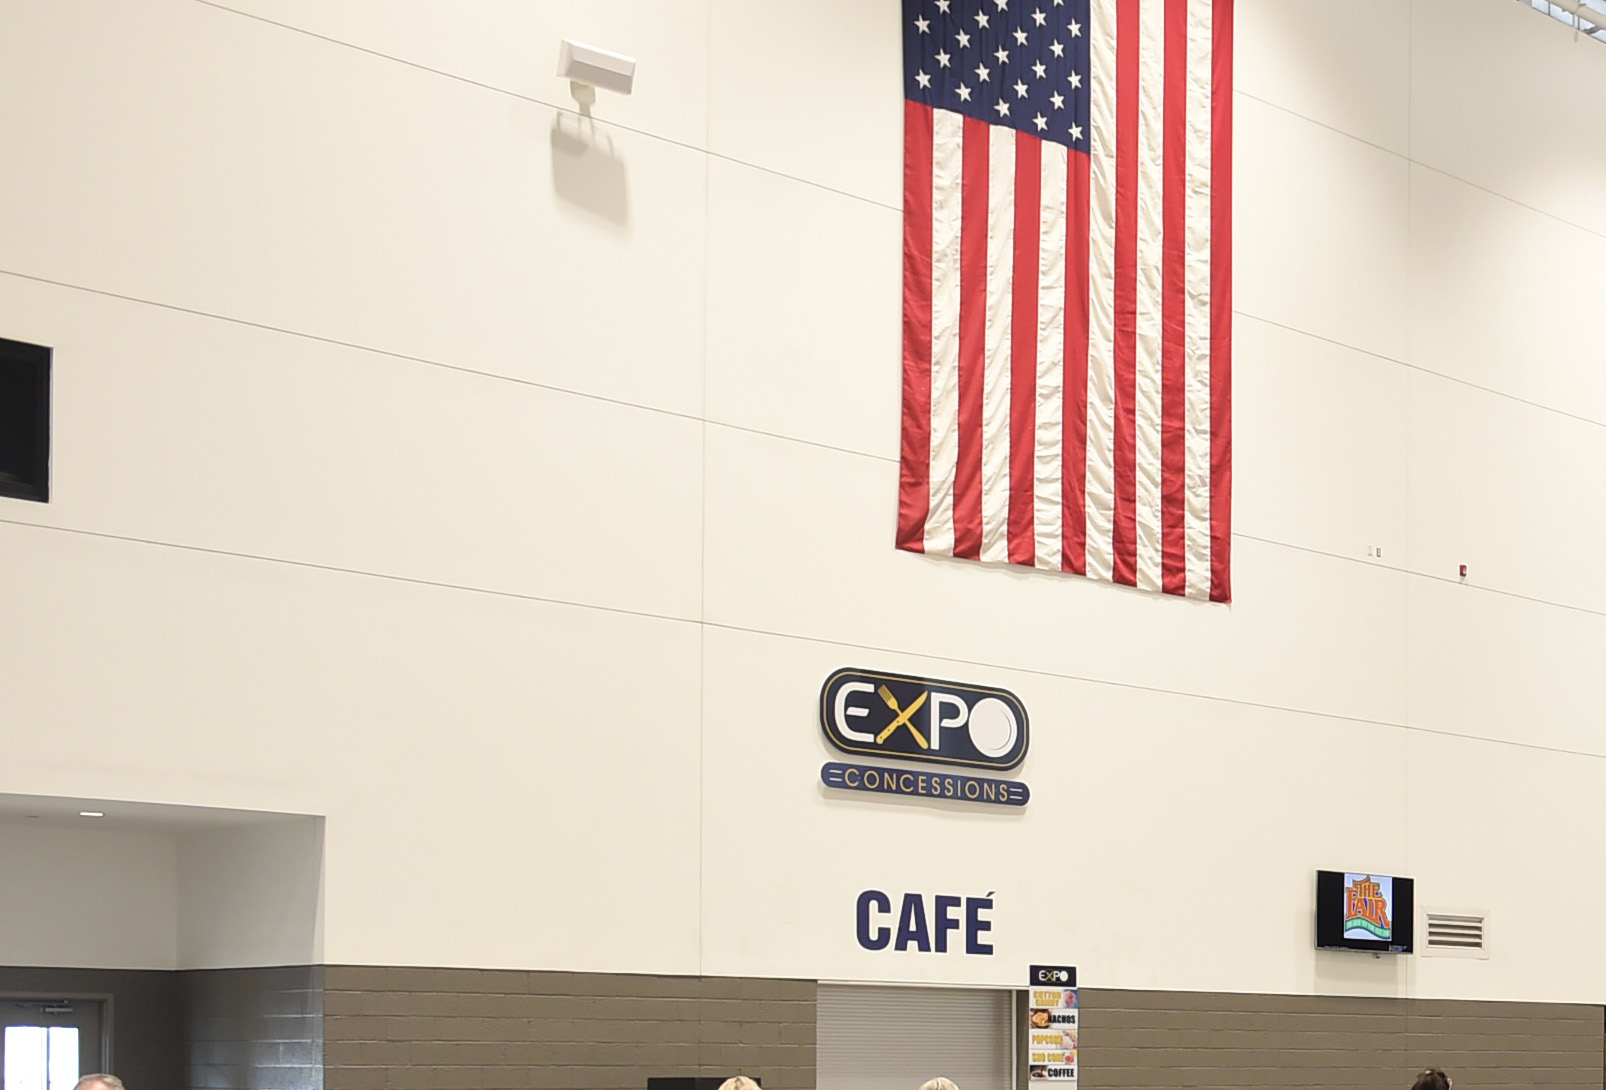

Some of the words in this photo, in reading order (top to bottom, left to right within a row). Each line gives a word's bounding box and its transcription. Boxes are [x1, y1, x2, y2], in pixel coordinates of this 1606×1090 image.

[834, 681, 1018, 758] EXPO
[844, 768, 1009, 803] CONCESSIONS
[1354, 876, 1382, 899] THE
[856, 889, 997, 956] CAFÉ
[1346, 888, 1390, 928] FAIR
[1038, 970, 1069, 983] EXPO
[1032, 1035, 1063, 1044] POPCORN
[1047, 1068, 1074, 1077] COFFEE
